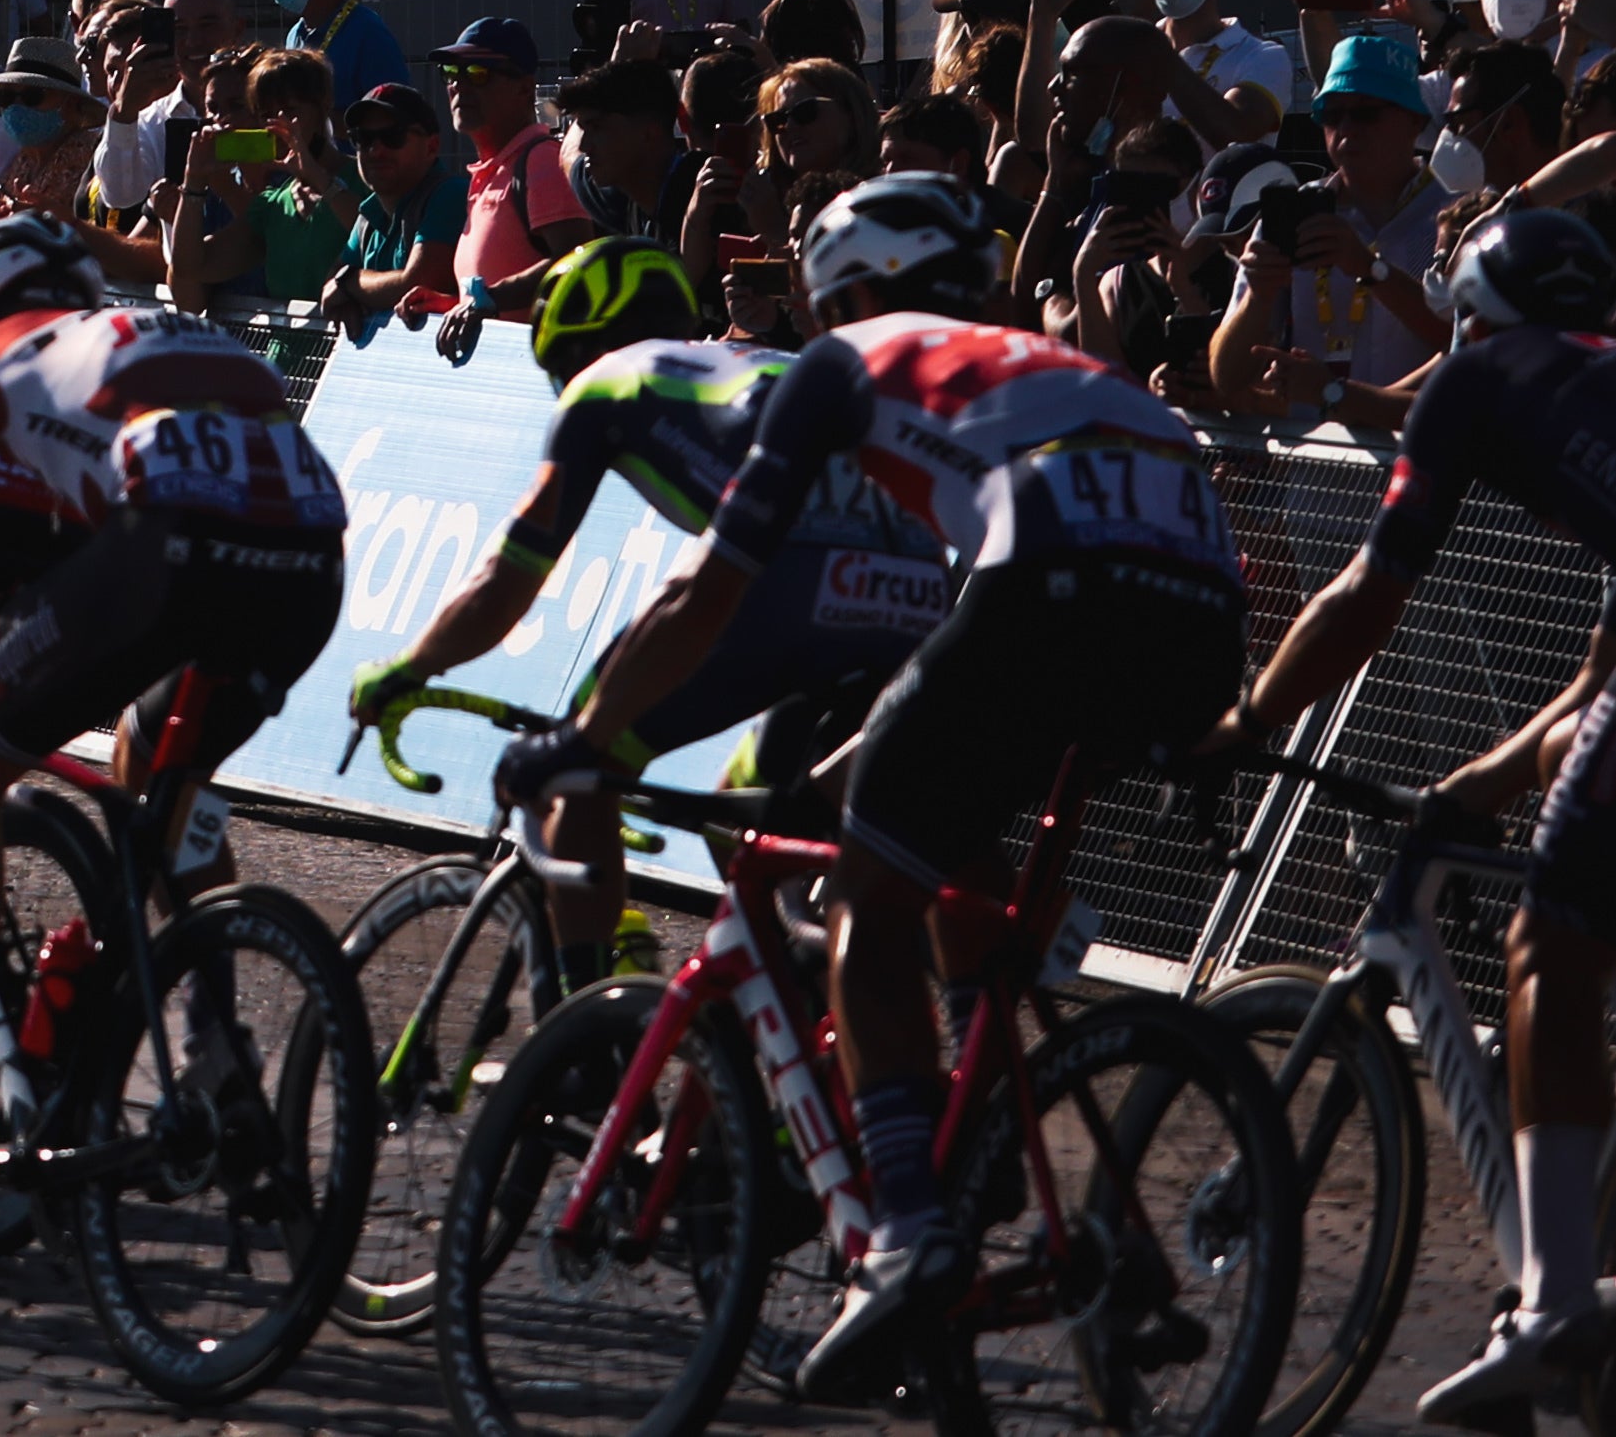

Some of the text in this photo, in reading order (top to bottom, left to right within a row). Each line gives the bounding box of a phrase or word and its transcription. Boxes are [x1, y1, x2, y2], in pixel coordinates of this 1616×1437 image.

[24, 410, 116, 461] TREK
[157, 410, 233, 476] 46
[895, 419, 994, 485] TREK
[1562, 428, 1616, 497] FEN
[1068, 452, 1141, 520] 47
[203, 537, 328, 573] TREK
[829, 551, 946, 612] Circus
[1104, 560, 1229, 614] TREK
[186, 808, 223, 854] 46
[704, 897, 875, 1263] TREK
